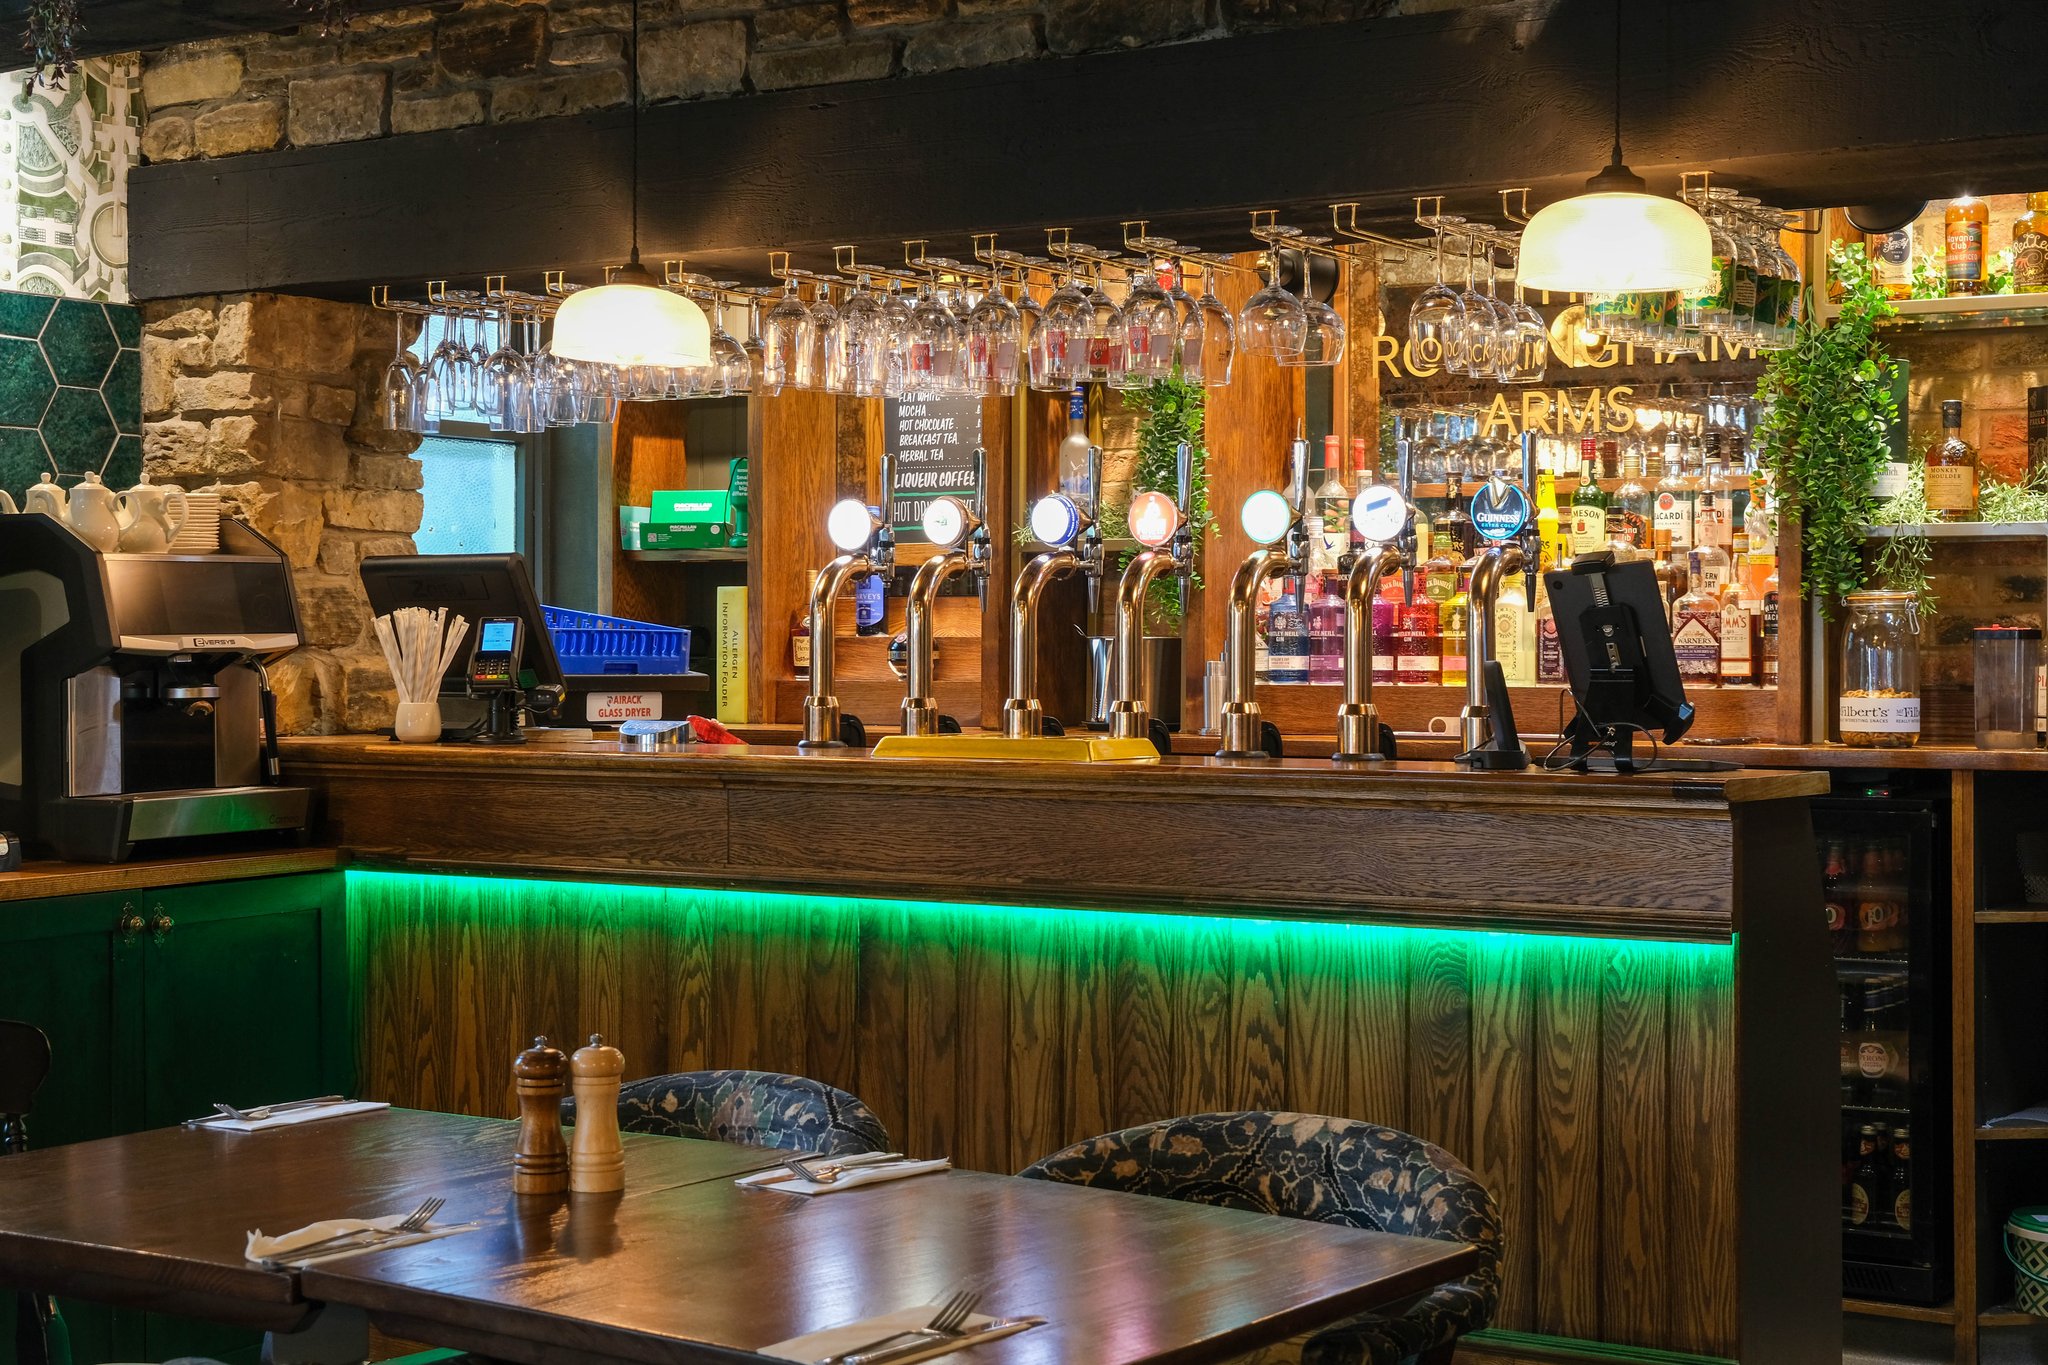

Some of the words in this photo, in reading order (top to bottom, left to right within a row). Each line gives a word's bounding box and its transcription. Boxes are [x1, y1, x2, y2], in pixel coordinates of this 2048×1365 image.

[1951, 241, 1967, 250] Club
[899, 404, 926, 418] MOCHA
[1482, 386, 1636, 438] ARMS
[899, 419, 914, 432] HOT
[914, 418, 954, 431] CHOCOLATE
[899, 433, 942, 446] BREAKFAST
[900, 449, 928, 463] HERBAL
[930, 448, 944, 461] TEA
[894, 472, 937, 489] LIQUEUR
[893, 501, 911, 522] HOT
[1476, 512, 1520, 524] GUINNESS
[731, 630, 739, 679] ALLERGEN
[721, 671, 729, 707] FOLDER
[598, 708, 623, 718] GLASS
[625, 707, 651, 717] DRYER
